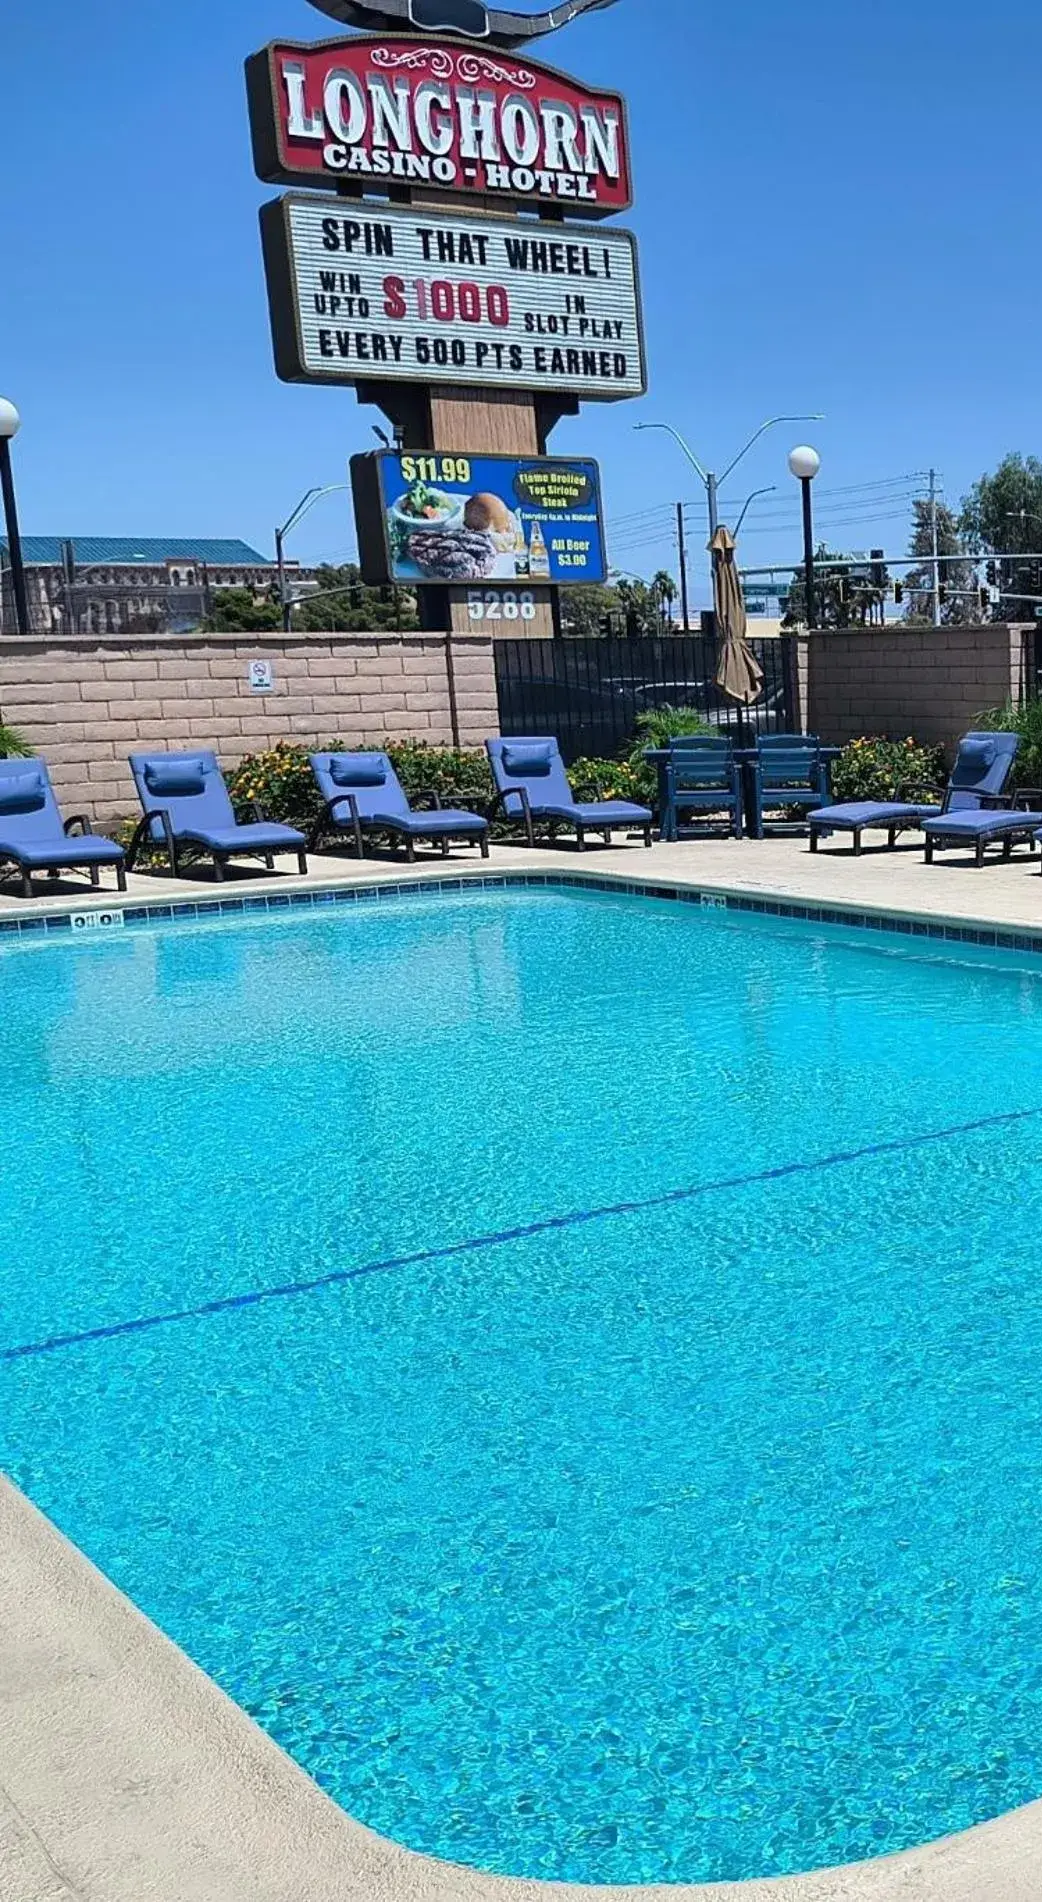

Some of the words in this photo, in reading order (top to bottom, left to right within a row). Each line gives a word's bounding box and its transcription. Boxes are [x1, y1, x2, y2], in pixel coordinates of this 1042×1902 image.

[282, 60, 620, 178] LONGHORN
[322, 142, 456, 181] CASINO
[485, 163, 597, 200] HOTEL
[322, 217, 394, 257] SPIN
[417, 227, 489, 265] THAT
[319, 270, 361, 294] WIN
[565, 294, 586, 315] IN
[524, 313, 570, 337] SLOT
[579, 317, 624, 341] PLAY
[318, 329, 403, 362] EVERY
[415, 336, 466, 366] 500
[475, 340, 523, 371] PTS
[534, 348, 627, 378] EARNED
[400, 455, 471, 483] $11.99
[566, 538, 590, 551] Beer
[467, 591, 536, 620] 5288
